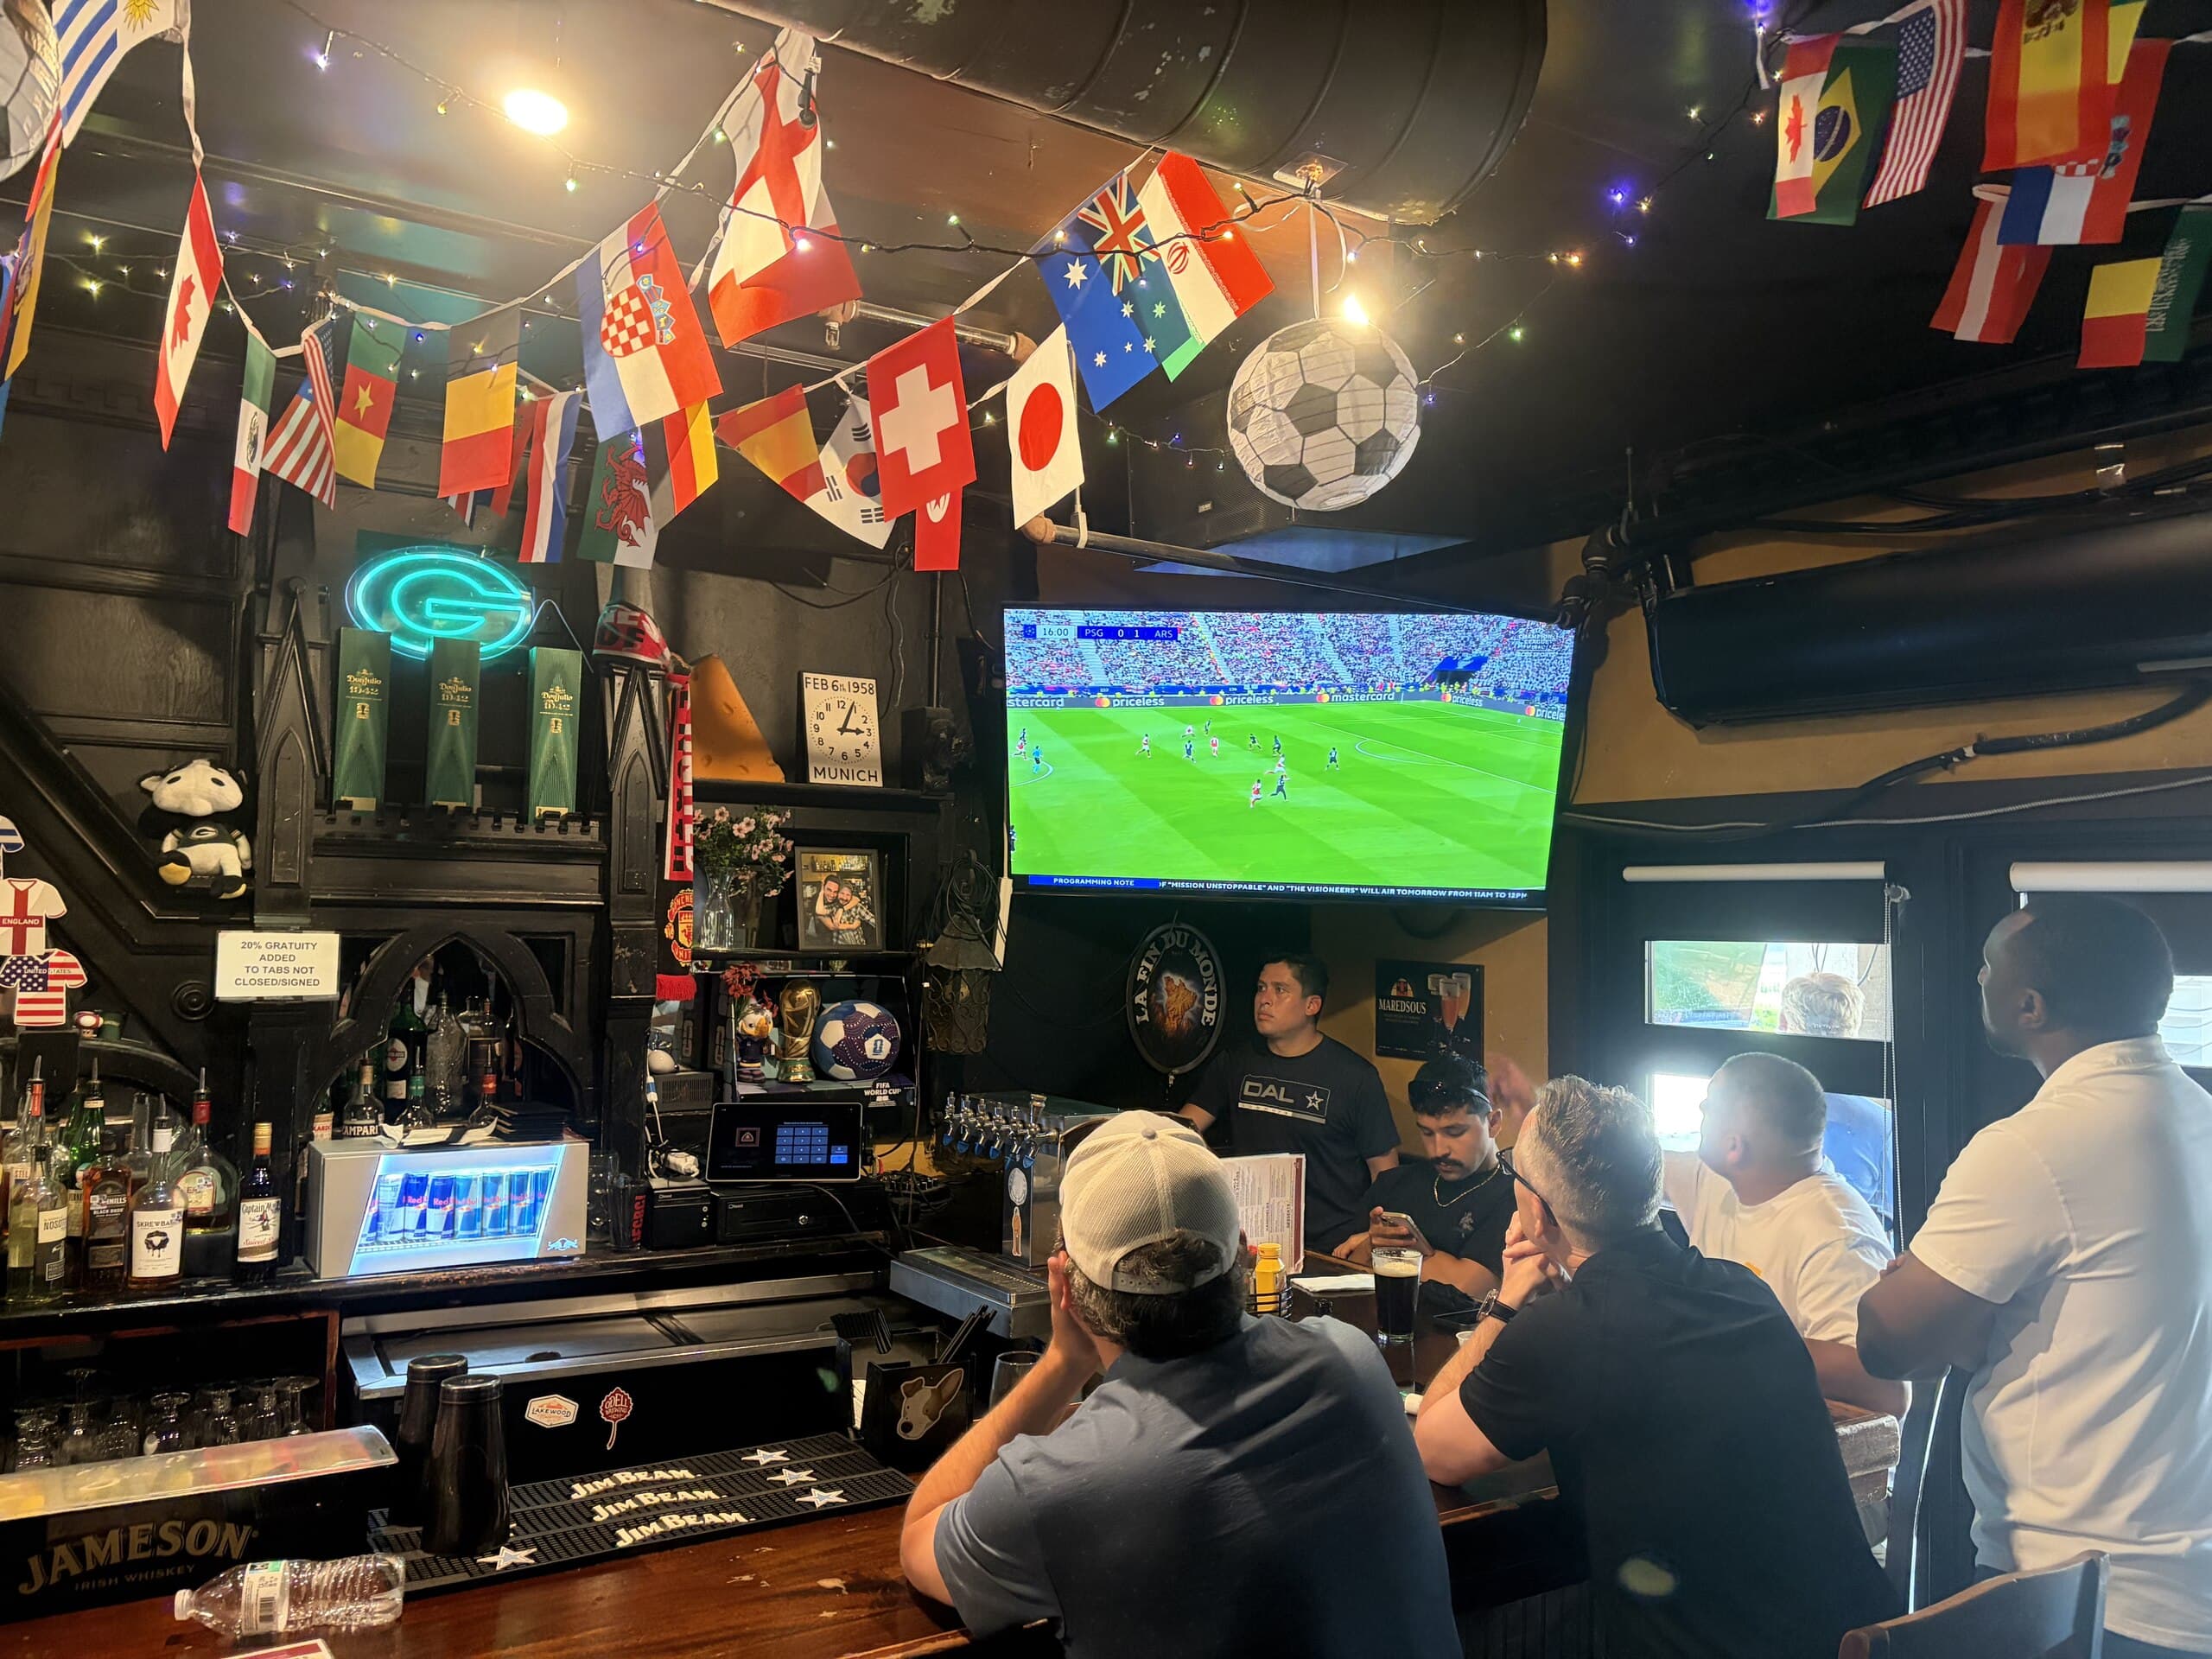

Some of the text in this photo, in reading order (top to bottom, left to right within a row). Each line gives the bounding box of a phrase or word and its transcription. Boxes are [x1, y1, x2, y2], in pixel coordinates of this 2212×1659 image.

[1042, 627, 1069, 637] 16:00
[1084, 628, 1173, 639] PSG 0 1 ARS
[804, 677, 875, 696] FEB 6th 1958
[1007, 696, 1065, 708] stercard
[1225, 695, 1274, 706] priceless
[1331, 691, 1395, 702] mastercard
[1452, 695, 1484, 707] priceless
[825, 702, 831, 712] 11
[836, 699, 847, 709] 12
[1112, 697, 1165, 708] priceless
[816, 711, 825, 721] 10
[861, 715, 868, 725] 2
[1535, 708, 1566, 721] pricele
[813, 723, 820, 733] 9
[866, 728, 872, 737] 3
[817, 737, 824, 747] 8
[863, 741, 870, 750] 4
[829, 747, 835, 756] 7
[841, 752, 849, 761] 6
[855, 748, 861, 759] 5
[813, 766, 879, 783] MUNICH
[1052, 877, 1112, 887] PROGRAMMING
[1396, 888, 1447, 897] TOMORROW
[240, 941, 318, 950] 20% GRATUITY
[1160, 930, 1190, 950] DU
[258, 953, 296, 963] ADDED
[1136, 941, 1161, 984] FIN
[244, 965, 315, 975] TO TABS NOT
[234, 977, 321, 987] CLOSED/SIGNED
[1188, 938, 1218, 1027] MONDE
[1134, 988, 1150, 1026] LA
[1378, 998, 1427, 1015] MAREDSOUS
[1243, 1080, 1295, 1104] DAL
[605, 1393, 628, 1409] ODELL
[531, 1407, 571, 1418] LAKEWOOD
[570, 1469, 696, 1500] JIM BEAM
[592, 1490, 721, 1522] JIM BEAM
[615, 1511, 749, 1548] JIM BEAM
[17, 1518, 253, 1596] JAMESON
[74, 1563, 196, 1592] IRISH WHISKEY
